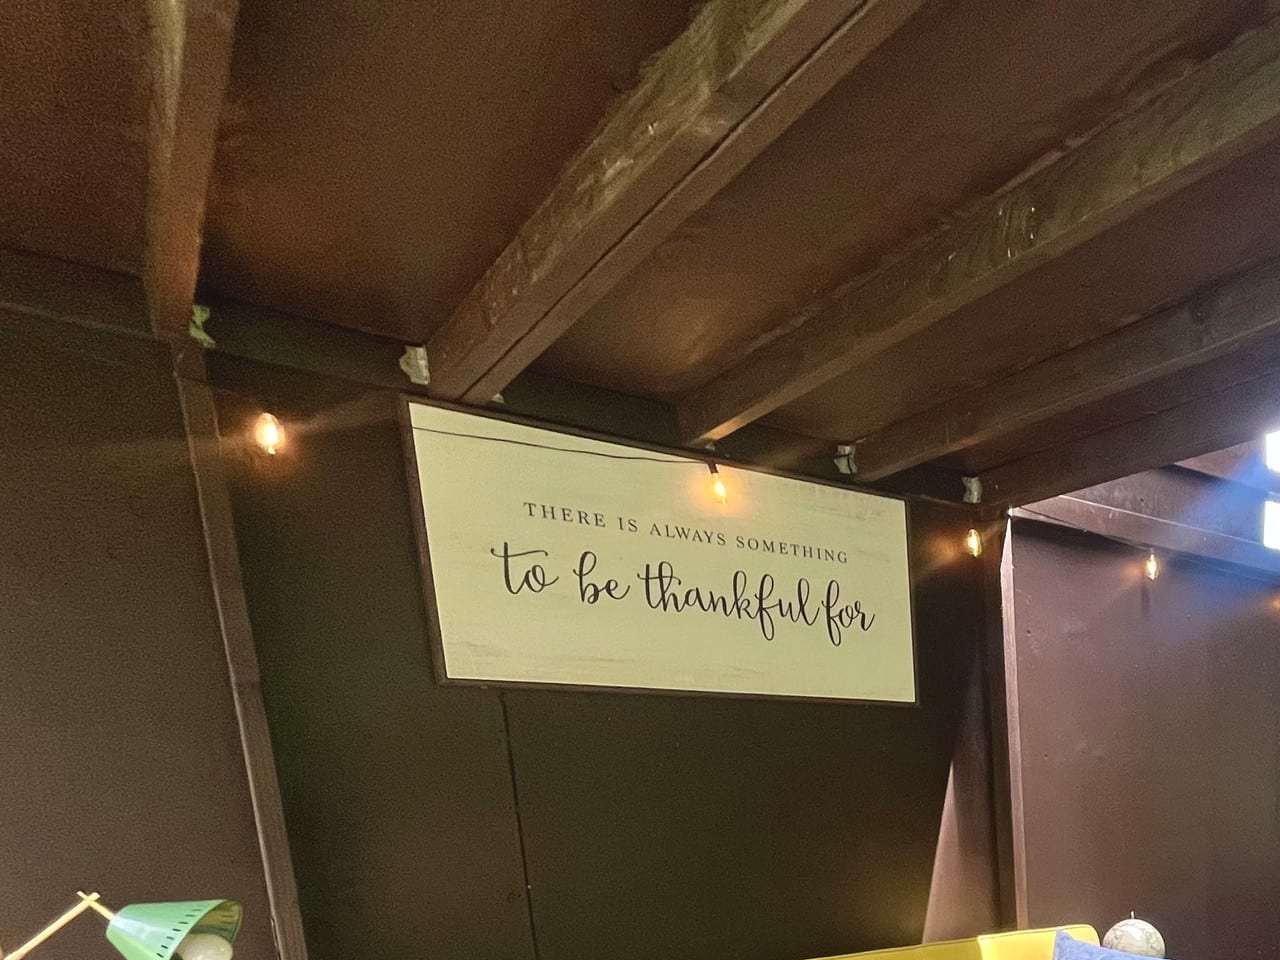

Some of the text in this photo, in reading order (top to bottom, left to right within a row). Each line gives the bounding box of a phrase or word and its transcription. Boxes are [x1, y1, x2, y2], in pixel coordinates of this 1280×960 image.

[523, 502, 849, 564] THERE IS ALWAYS SOMETHING
[490, 541, 876, 648] to be thankful for
